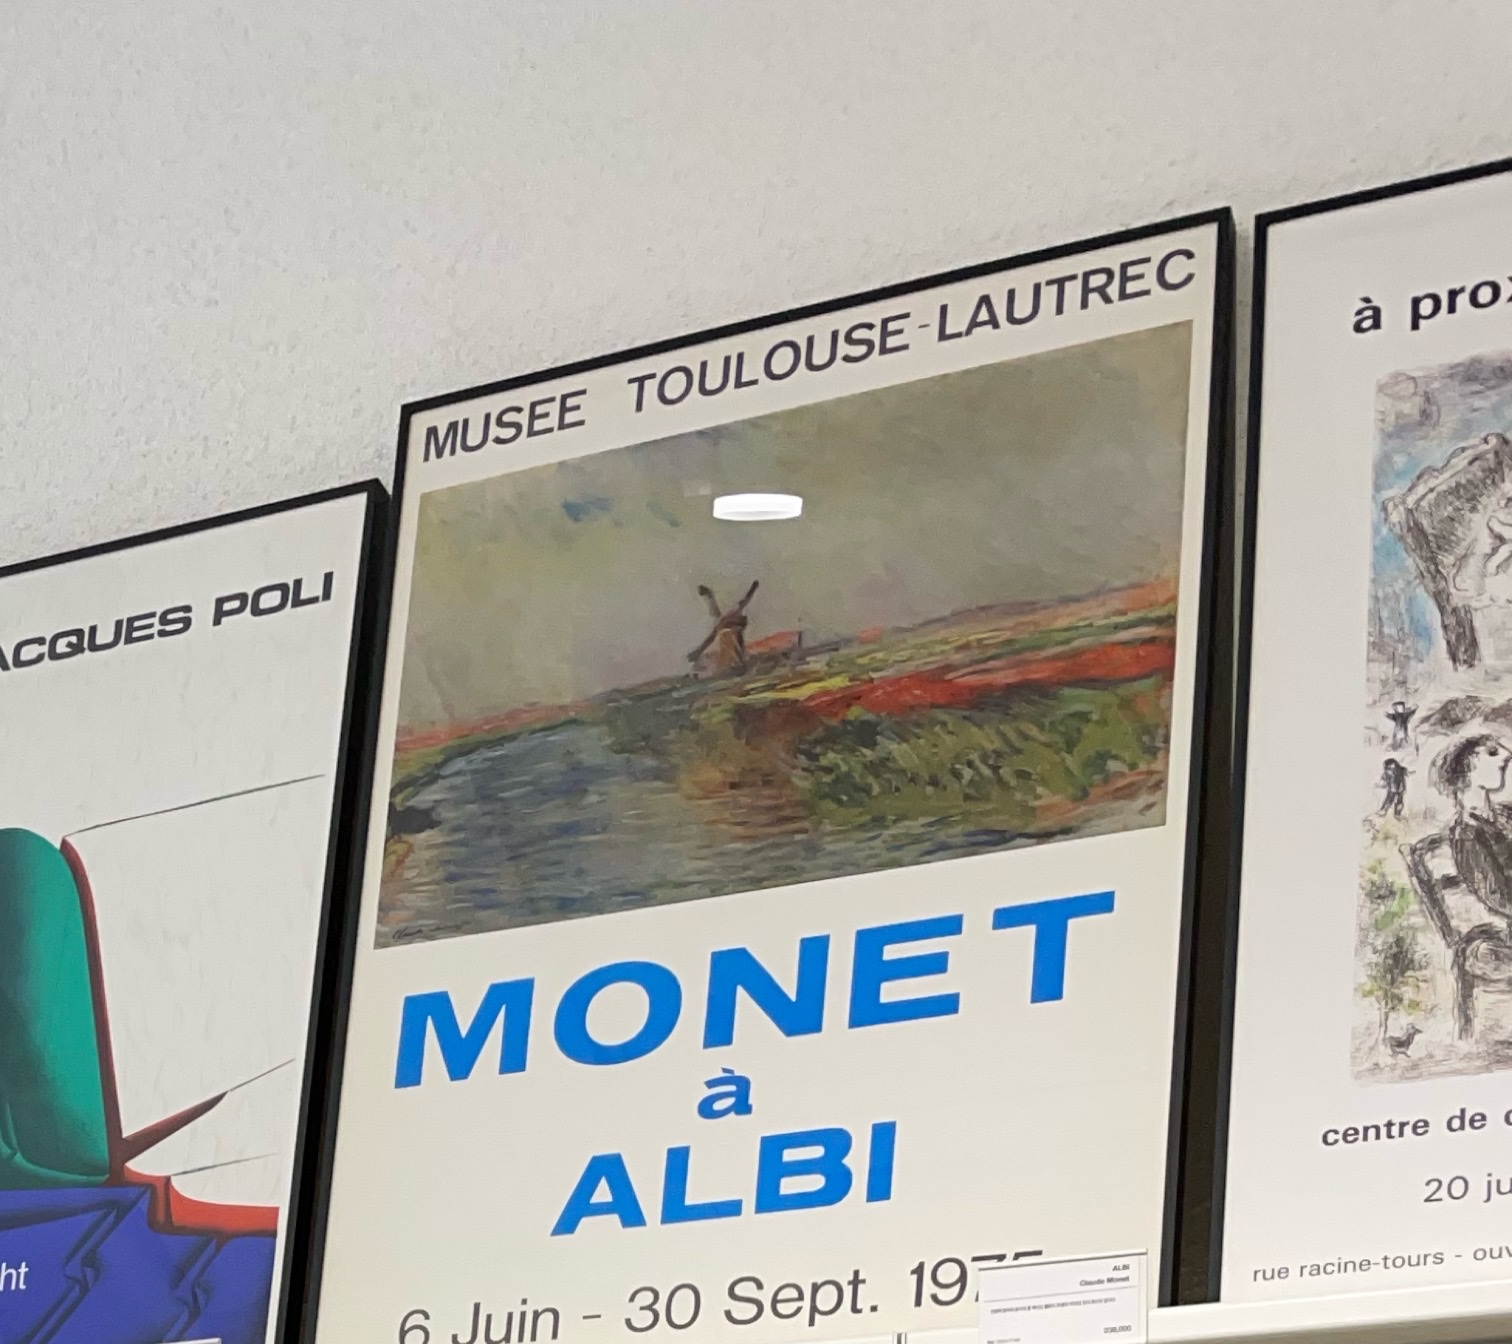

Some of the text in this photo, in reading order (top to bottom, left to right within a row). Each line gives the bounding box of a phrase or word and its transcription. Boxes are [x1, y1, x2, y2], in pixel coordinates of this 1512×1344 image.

[1353, 296, 1382, 334] à
[423, 388, 588, 463] MUSEE
[213, 572, 334, 627] POLI
[394, 890, 1116, 1089] MONET
[697, 1066, 754, 1121] à
[1321, 1107, 1488, 1147] centre de
[550, 1121, 898, 1238] ALBI
[1423, 1175, 1469, 1203] 20
[1253, 1250, 1445, 1283] rue racine-tours
[623, 1284, 702, 1333] 30
[723, 1268, 880, 1328] Sept.
